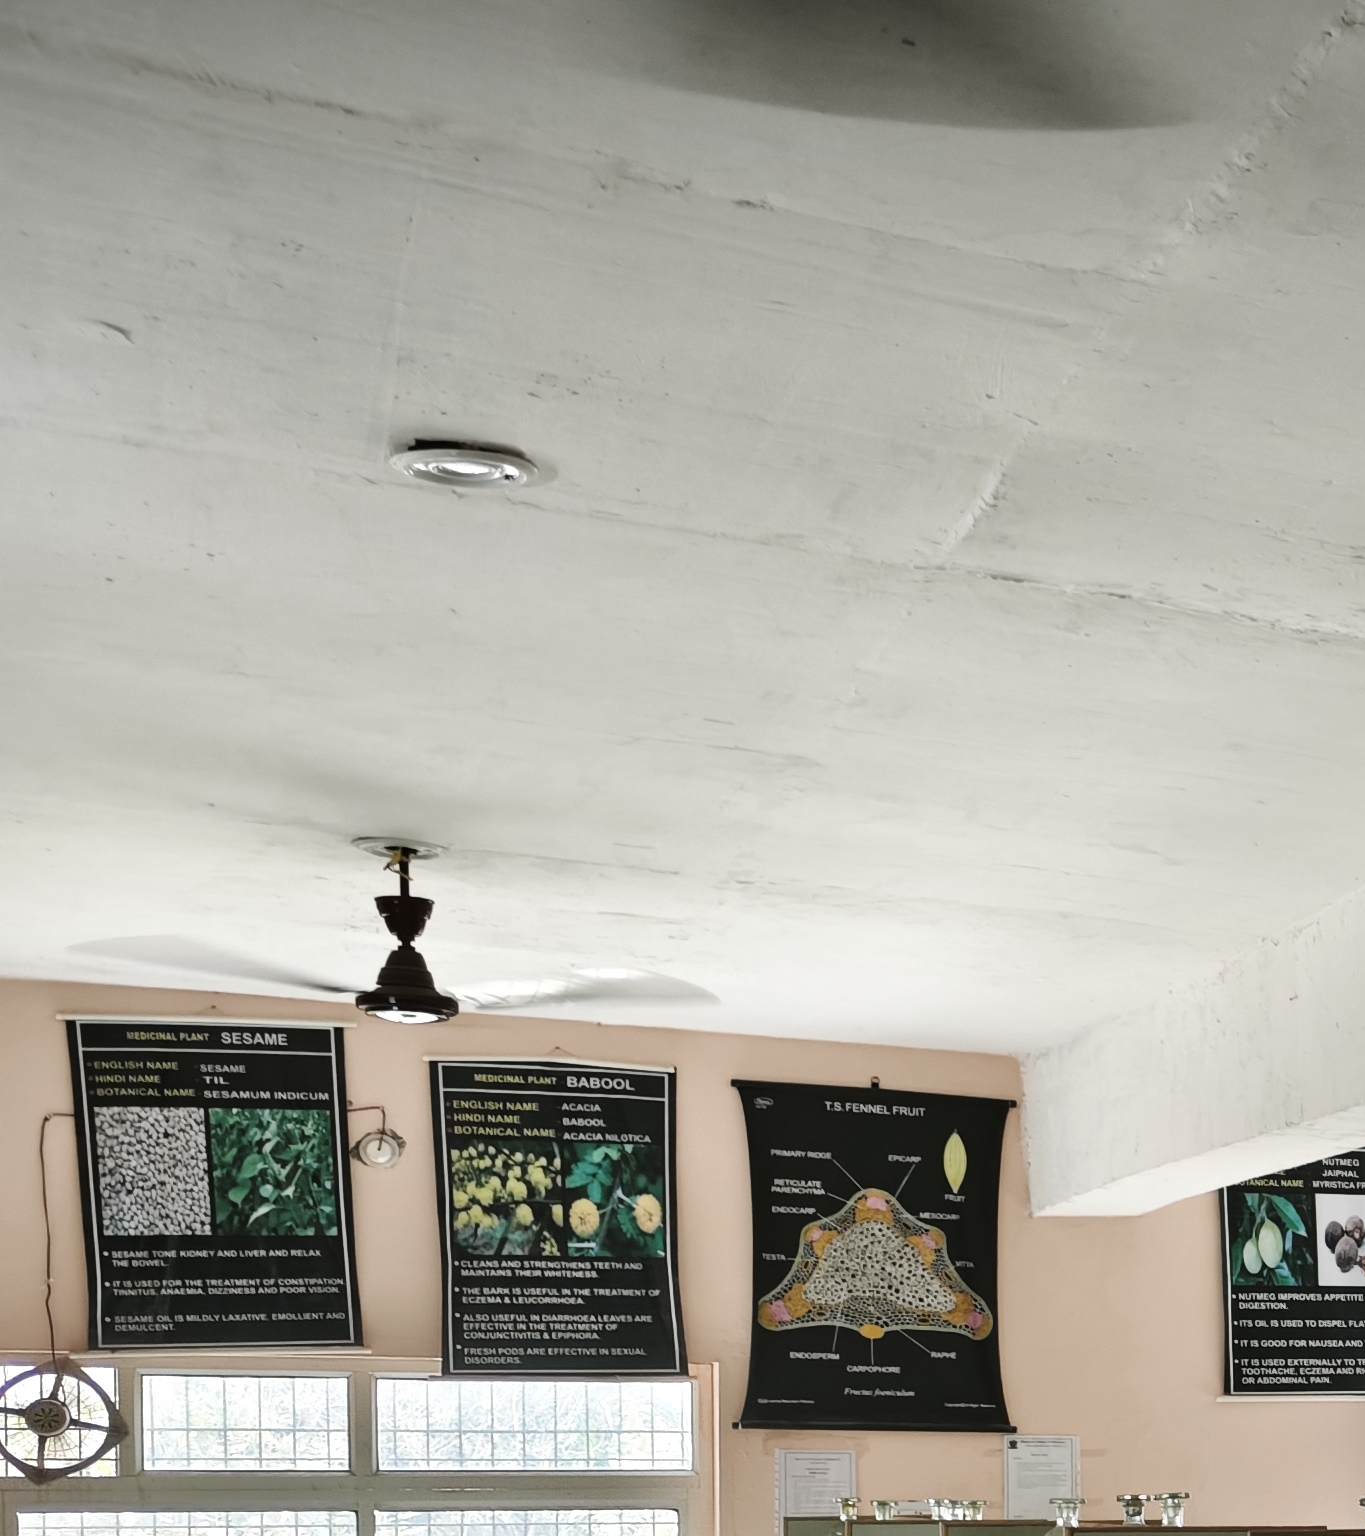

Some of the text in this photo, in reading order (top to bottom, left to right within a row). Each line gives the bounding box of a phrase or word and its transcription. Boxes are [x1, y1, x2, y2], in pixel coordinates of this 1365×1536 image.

[126, 1031, 288, 1046] MEDICINAL PLANT SESAME
[94, 1062, 246, 1074] ENGLISH NAME SESAME
[96, 1075, 230, 1085] HINDI NAME TIL
[474, 1074, 635, 1090] MEDICINAL PLANT BABOOL
[96, 1088, 330, 1101] BOTANICAL NAME SESAMUM INDICUM
[453, 1101, 601, 1112] ENGLISH NAME ACACIA
[825, 1101, 925, 1116] T.S. FENNEL FRUIT
[454, 1114, 606, 1127] HINDI NAME BABOOL
[454, 1127, 651, 1143] BOTANICAL NAME ACACIA NILOTICA
[1322, 1159, 1360, 1167] NUTMEG
[1322, 1170, 1359, 1178] JAIPHAL
[1281, 1179, 1304, 1187] NAME
[1312, 1180, 1355, 1189] MYRISTICA
[152, 1250, 176, 1258] TONE
[217, 1250, 237, 1258] AND
[268, 1250, 288, 1258] AND
[290, 1250, 321, 1258] RELAX
[461, 1260, 499, 1268] CLEANS
[524, 1261, 591, 1269] STRENGTHENS
[624, 1262, 643, 1270] AND
[515, 1269, 542, 1277] THEIR
[112, 1280, 120, 1288] IT
[122, 1280, 131, 1288] IS
[136, 1280, 160, 1288] USED
[162, 1279, 182, 1287] FOR
[185, 1279, 203, 1287] THE
[262, 1278, 276, 1286] OF
[258, 1286, 278, 1294] AND
[280, 1286, 306, 1294] POOR
[463, 1287, 481, 1295] THE
[483, 1287, 510, 1295] BARK
[512, 1287, 521, 1295] IS
[574, 1288, 591, 1296] THE
[463, 1296, 502, 1304] ECZEMA
[1278, 1293, 1322, 1301] IMPROVES
[114, 1315, 154, 1323] SESAME
[174, 1314, 184, 1322] IS
[326, 1312, 346, 1320] AND
[492, 1314, 528, 1322] USEFUL
[549, 1323, 603, 1331] TREATMENT
[548, 1348, 597, 1356] EFFECTIVE
[611, 1348, 647, 1356] SEXUAL
